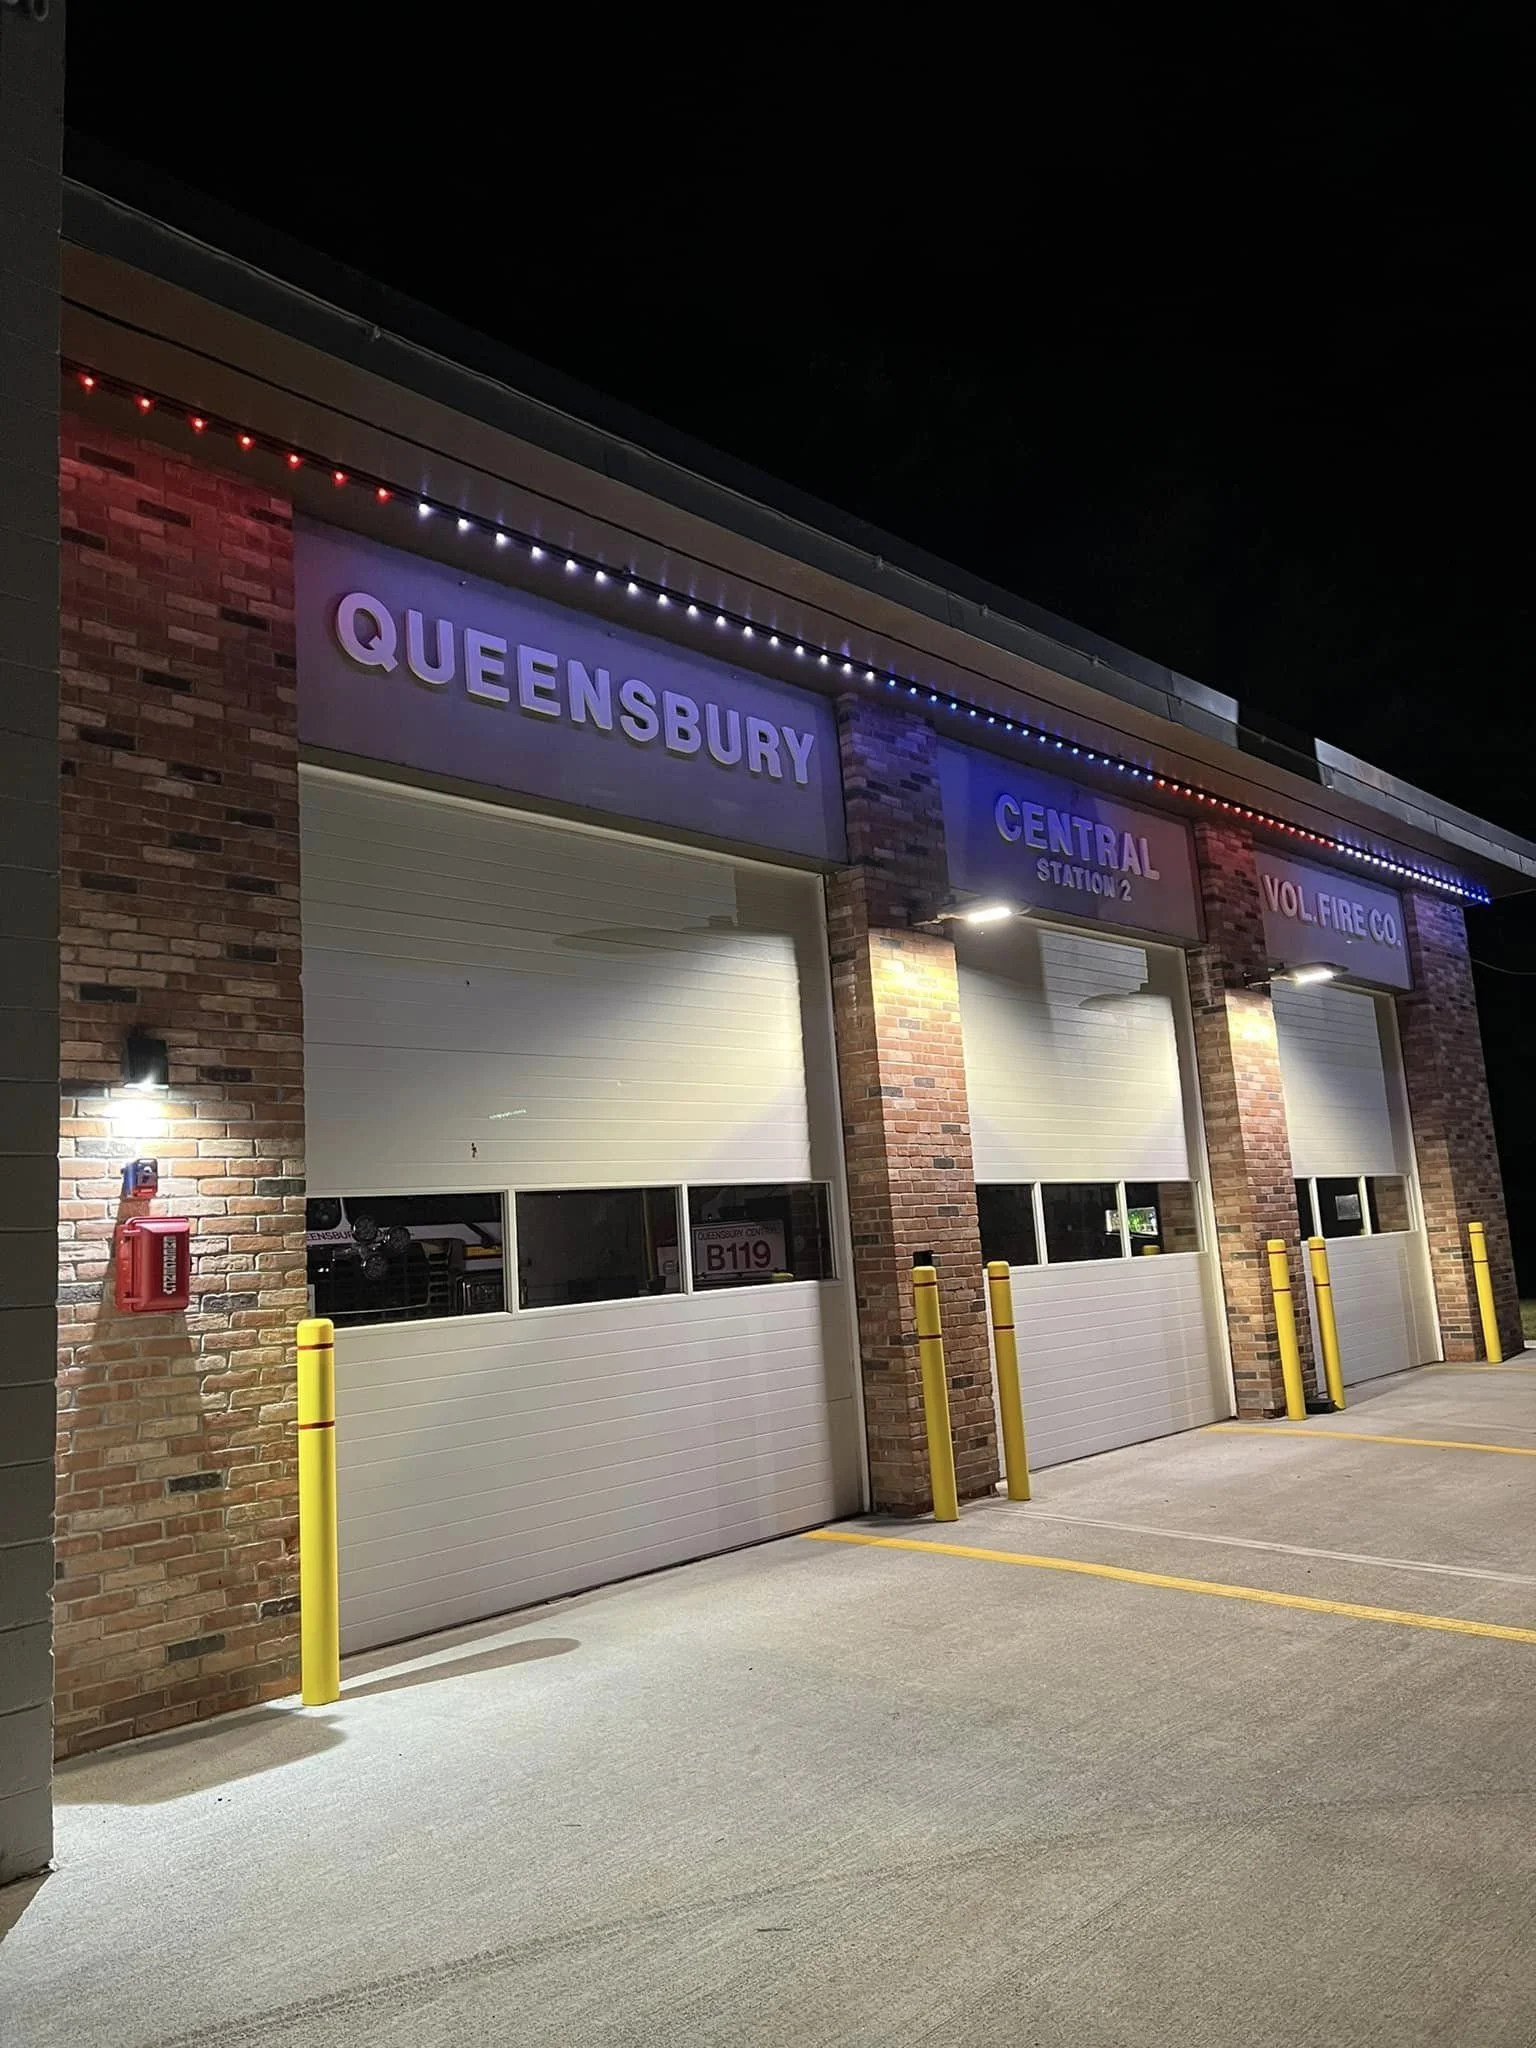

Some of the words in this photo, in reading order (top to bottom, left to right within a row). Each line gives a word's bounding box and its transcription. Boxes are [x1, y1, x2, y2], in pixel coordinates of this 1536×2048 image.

[336, 592, 815, 784] QUEENSBURY
[995, 794, 1161, 881] CENTRAL
[1036, 857, 1115, 898] STATION
[1120, 879, 1133, 902] 2
[1369, 908, 1402, 947] CO.
[707, 1240, 771, 1270] B119
